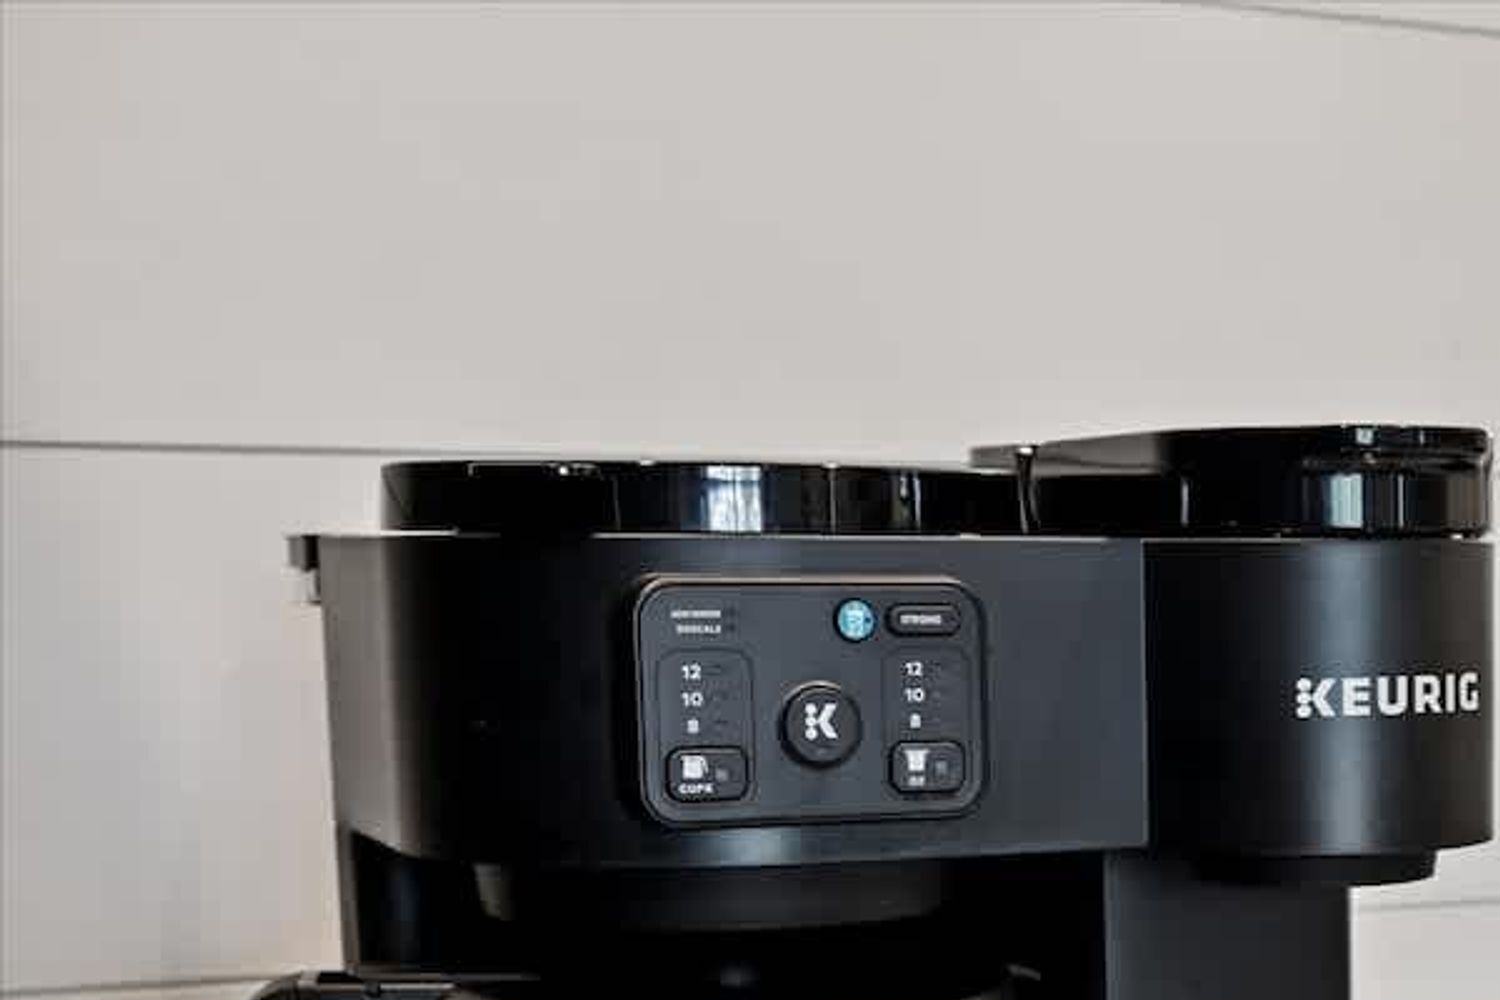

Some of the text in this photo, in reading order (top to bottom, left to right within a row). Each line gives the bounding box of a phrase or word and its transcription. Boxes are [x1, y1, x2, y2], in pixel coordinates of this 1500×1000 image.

[681, 663, 702, 680] 12
[904, 661, 923, 677] 12
[681, 691, 704, 708] 10
[904, 687, 925, 702] 10
[1296, 671, 1480, 719] KEURIG
[804, 702, 838, 741] K
